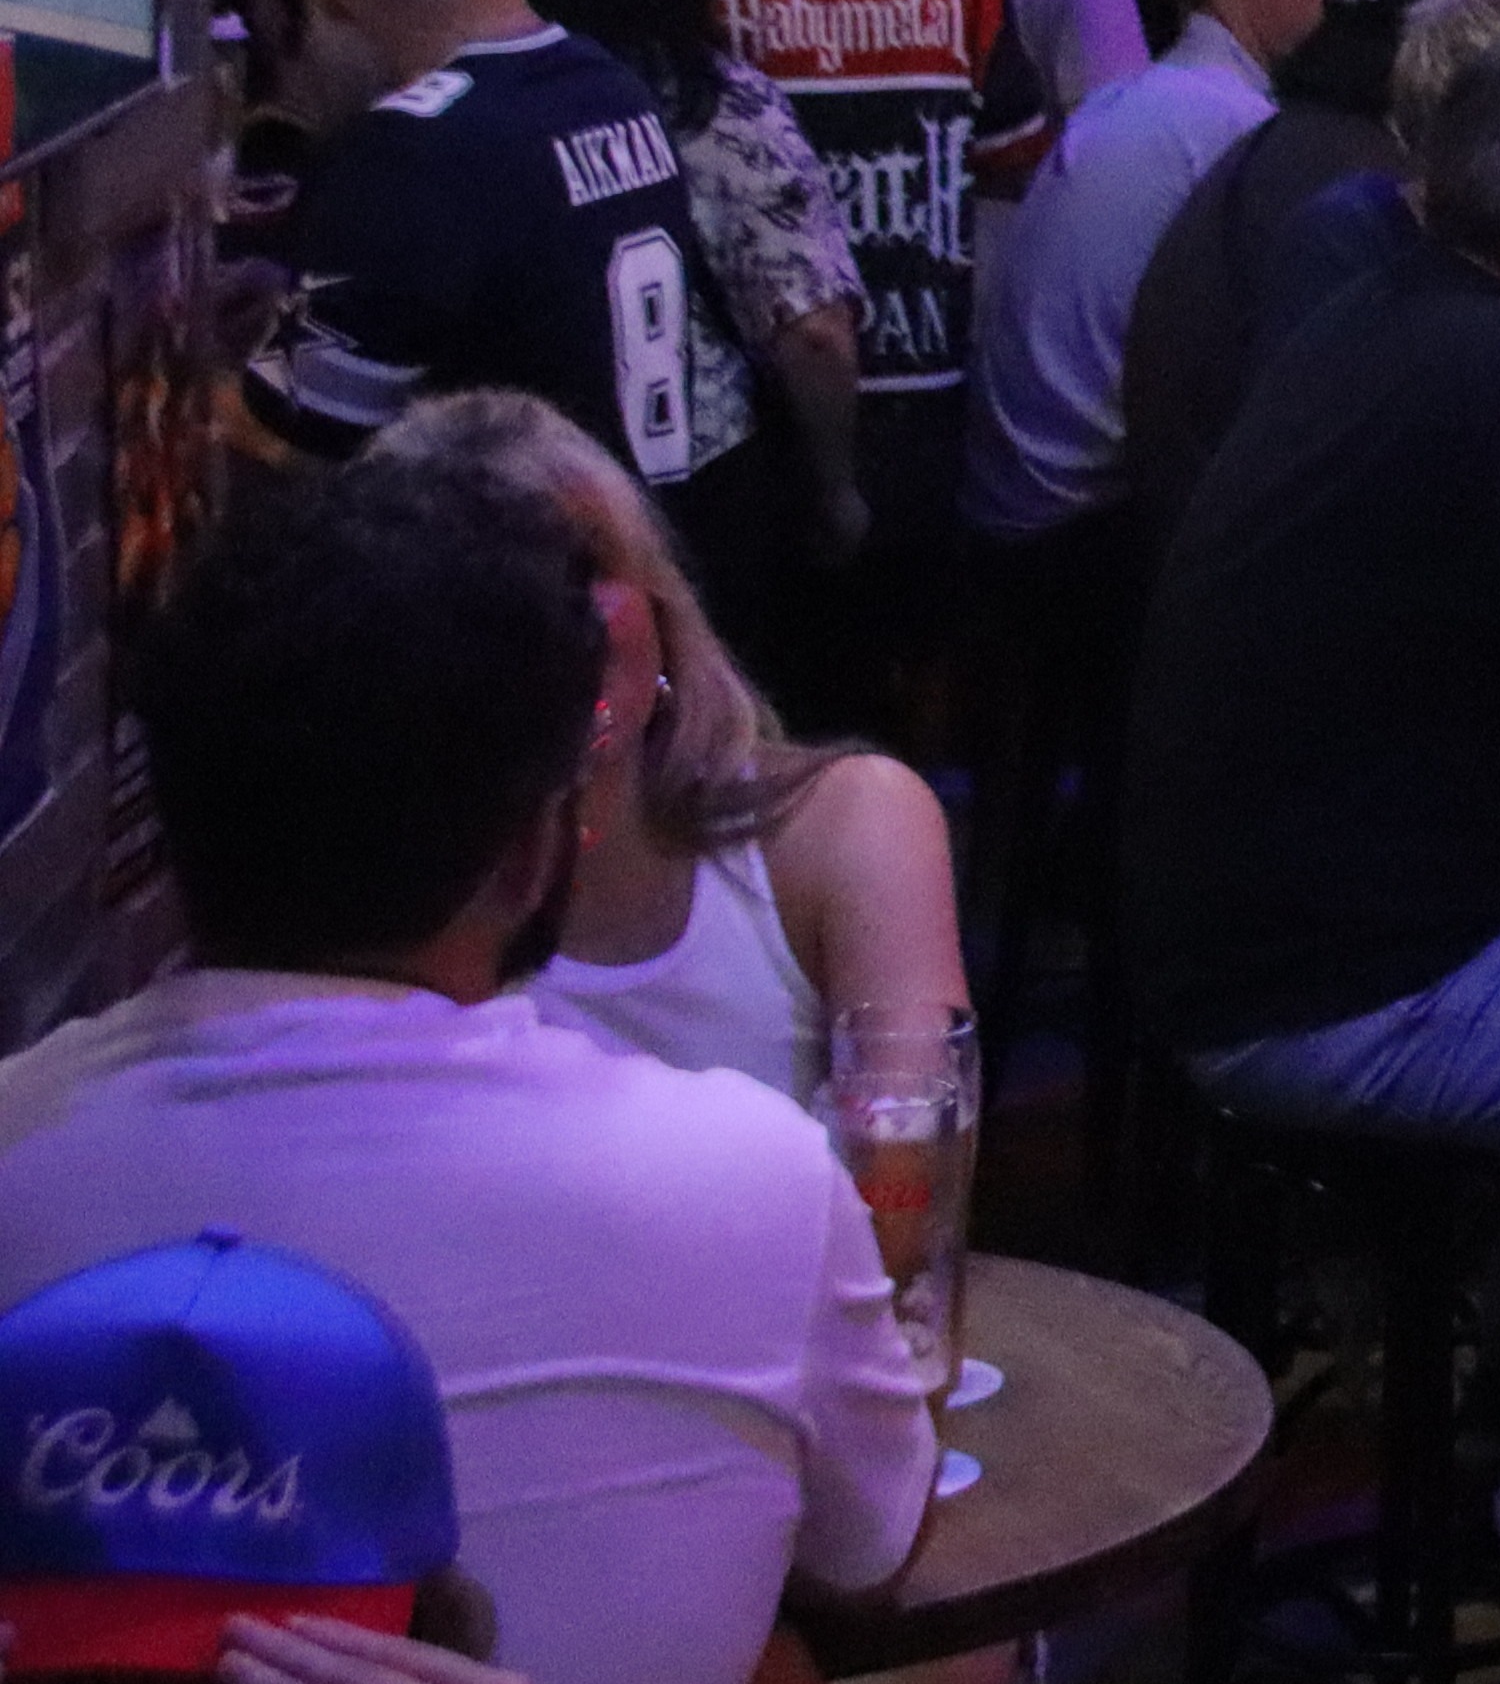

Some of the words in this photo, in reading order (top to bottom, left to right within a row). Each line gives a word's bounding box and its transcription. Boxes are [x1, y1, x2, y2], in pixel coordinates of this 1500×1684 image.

[551, 114, 680, 207] AIKMAN
[606, 228, 690, 484] 8
[14, 1404, 306, 1520] Coors
